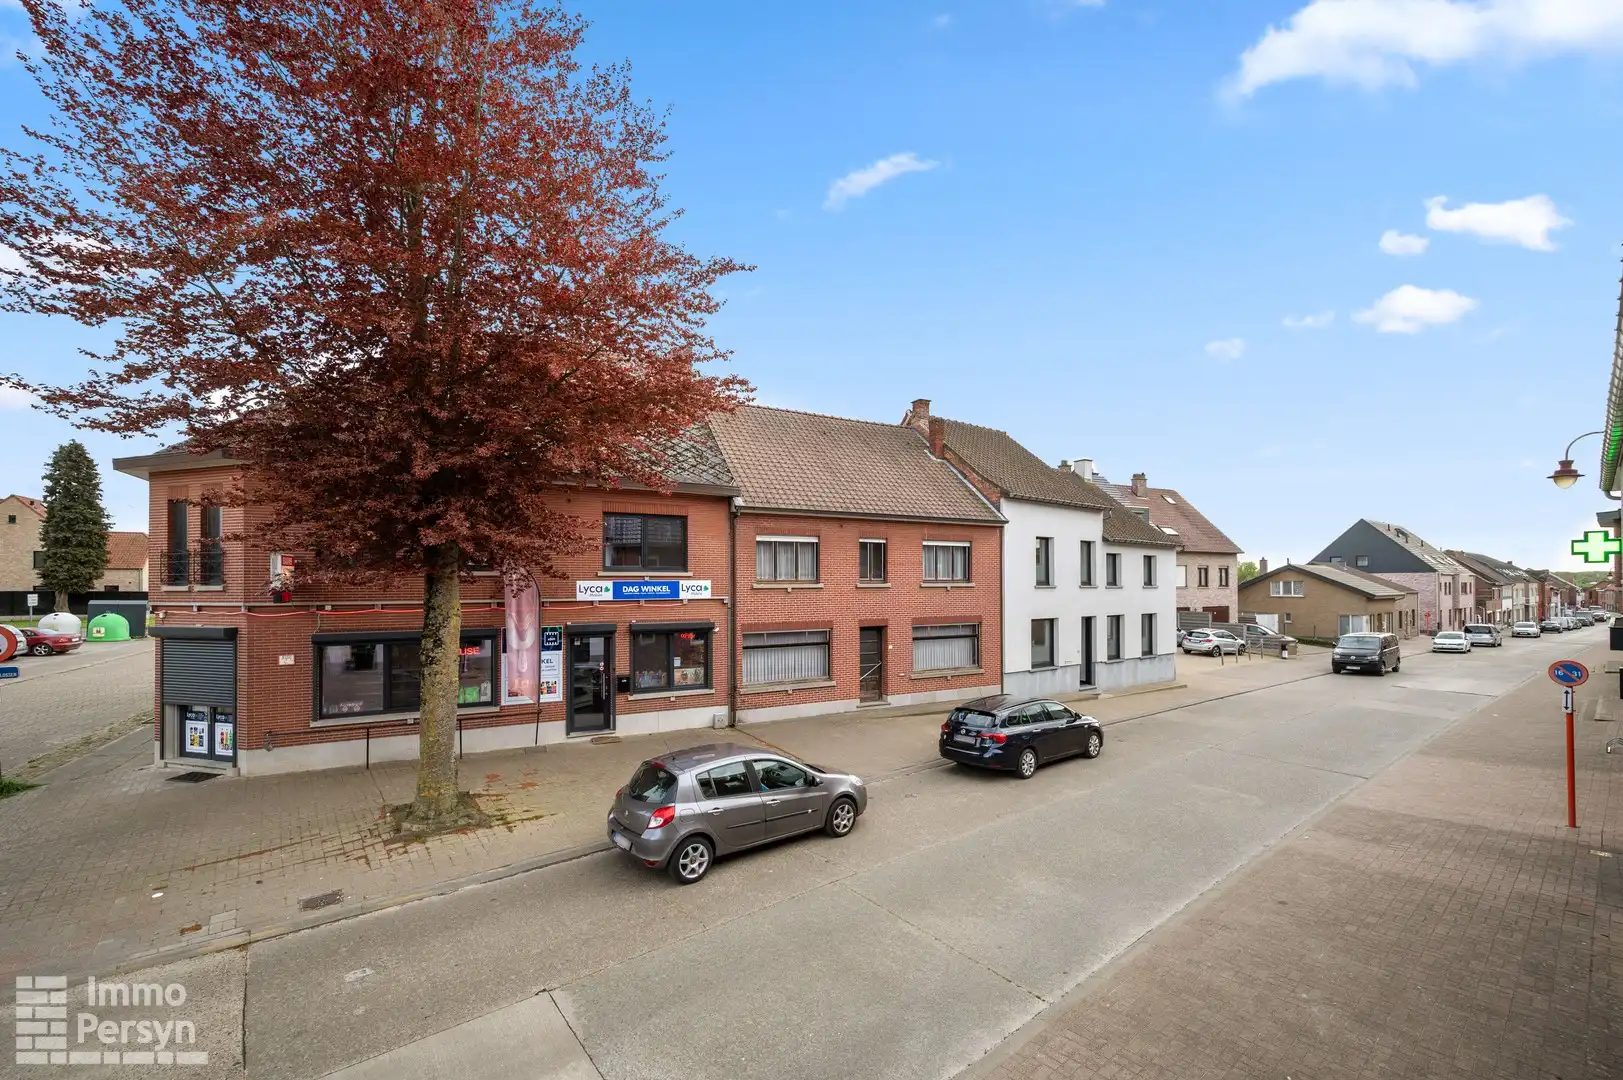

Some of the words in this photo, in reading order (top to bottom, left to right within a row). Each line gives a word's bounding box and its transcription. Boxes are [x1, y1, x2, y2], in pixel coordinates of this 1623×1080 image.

[578, 584, 603, 594] Lyca
[622, 585, 639, 593] DAG
[681, 583, 703, 593] Lyca
